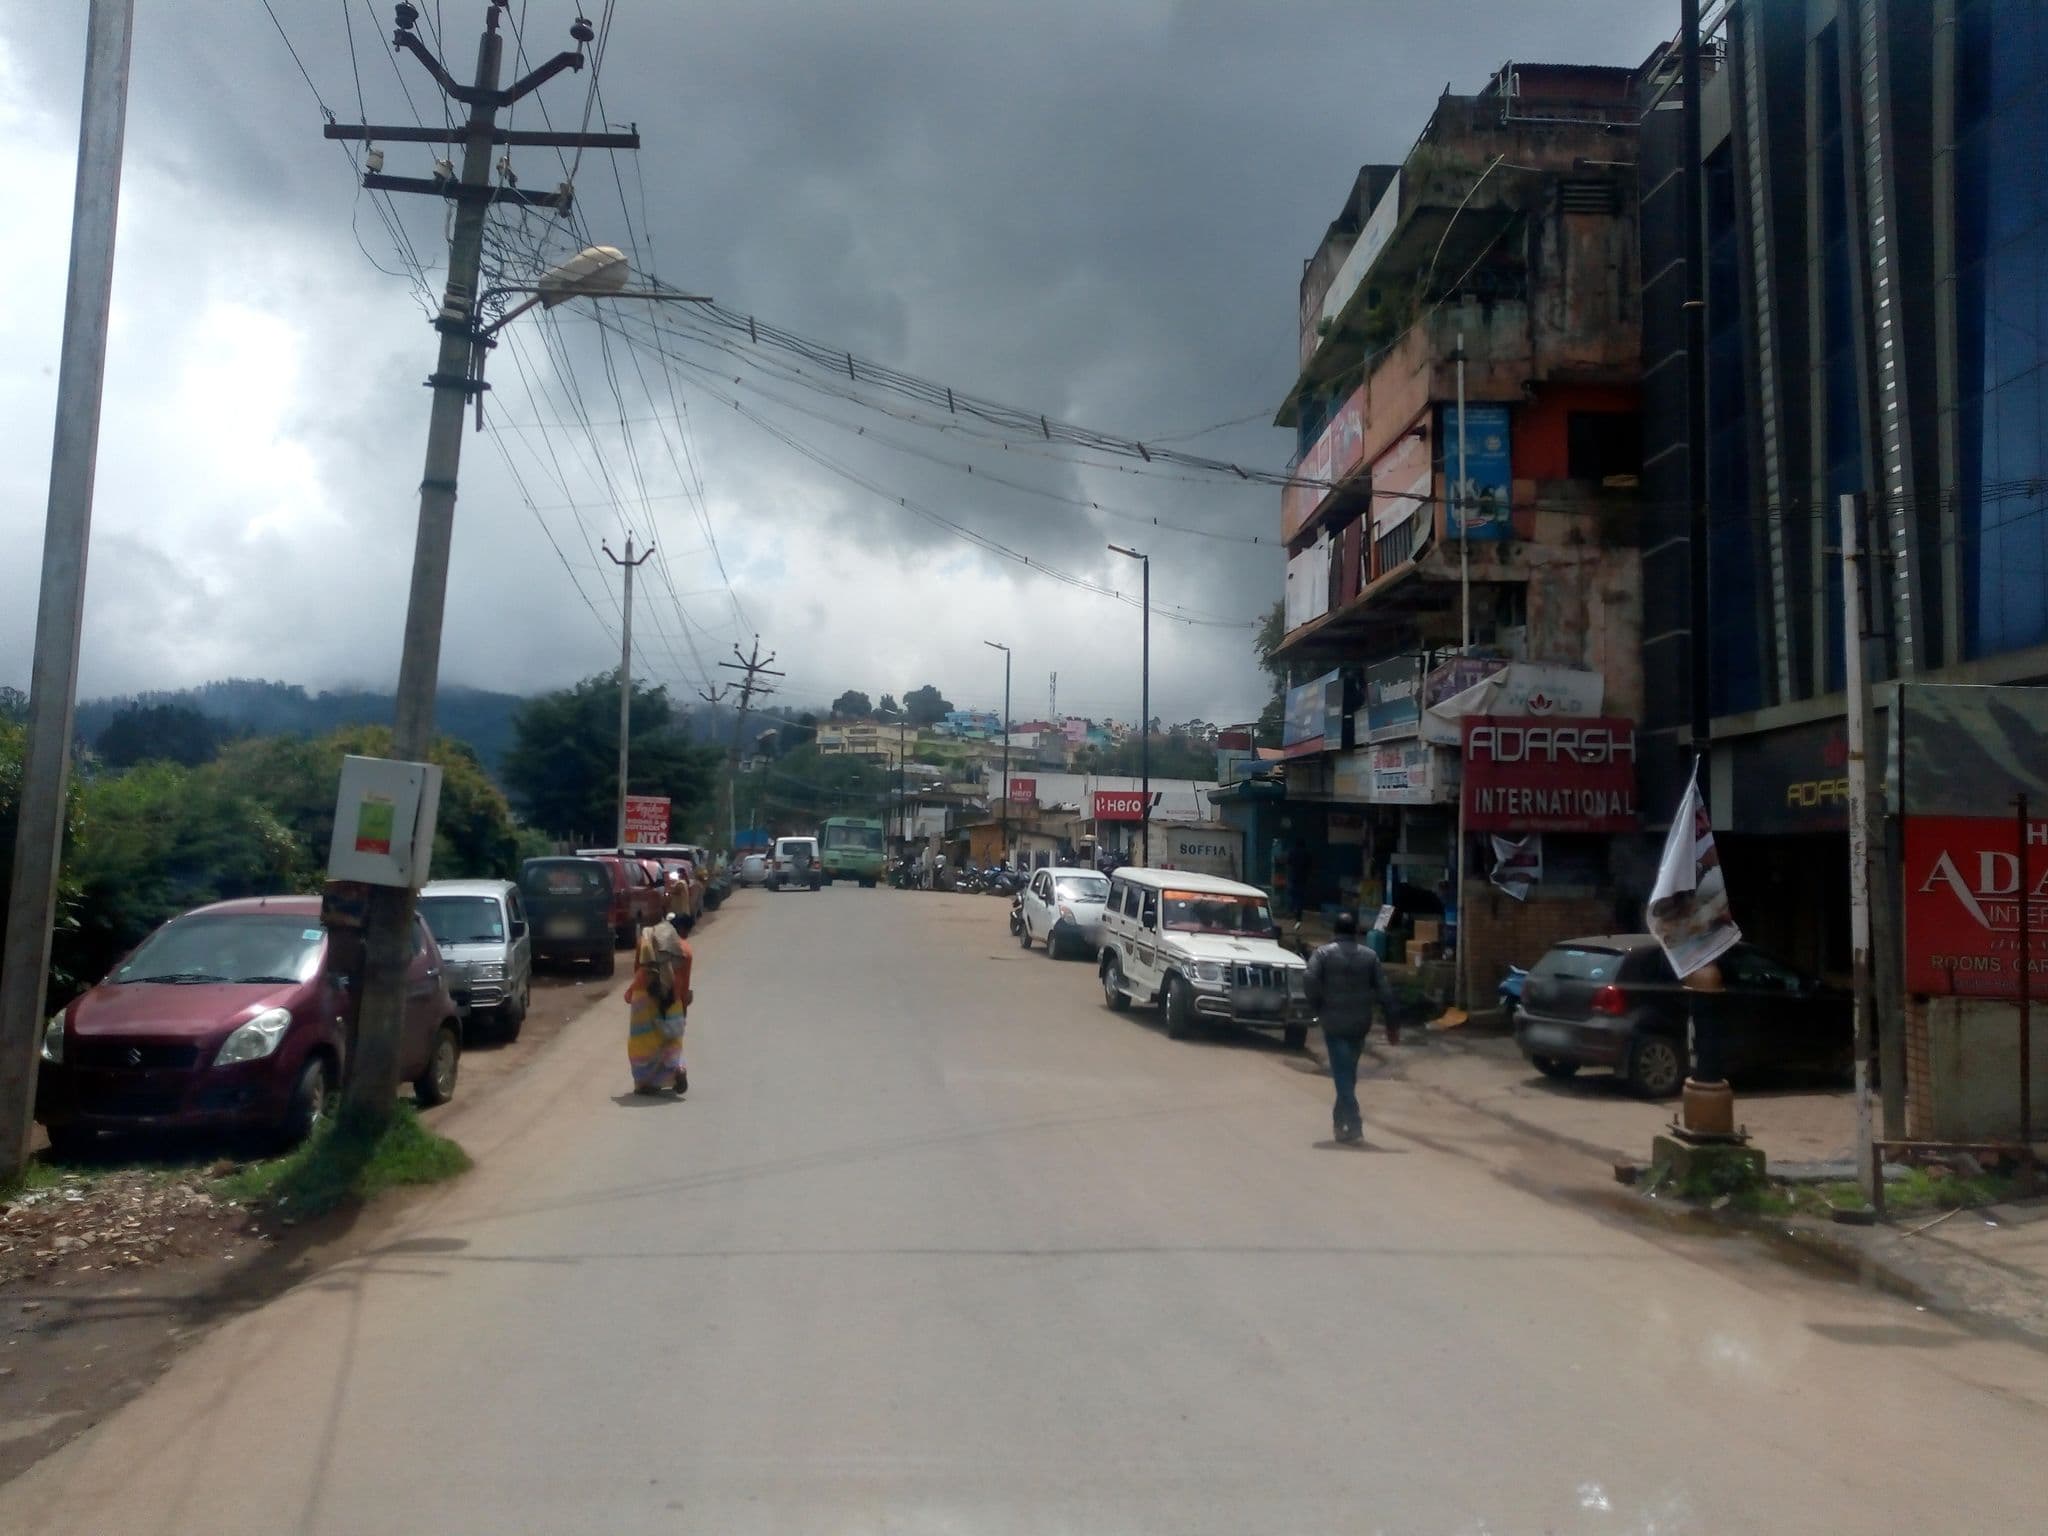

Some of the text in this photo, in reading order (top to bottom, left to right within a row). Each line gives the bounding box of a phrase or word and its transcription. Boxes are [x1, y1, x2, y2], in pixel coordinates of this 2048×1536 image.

[1468, 726, 1636, 764] ADARSH
[1107, 799, 1142, 813] Hero
[1475, 787, 1636, 817] INTERNATIONAL
[637, 831, 667, 844] NTC
[1179, 843, 1227, 857] SOFFIA
[1931, 954, 2001, 972] ROOMS
